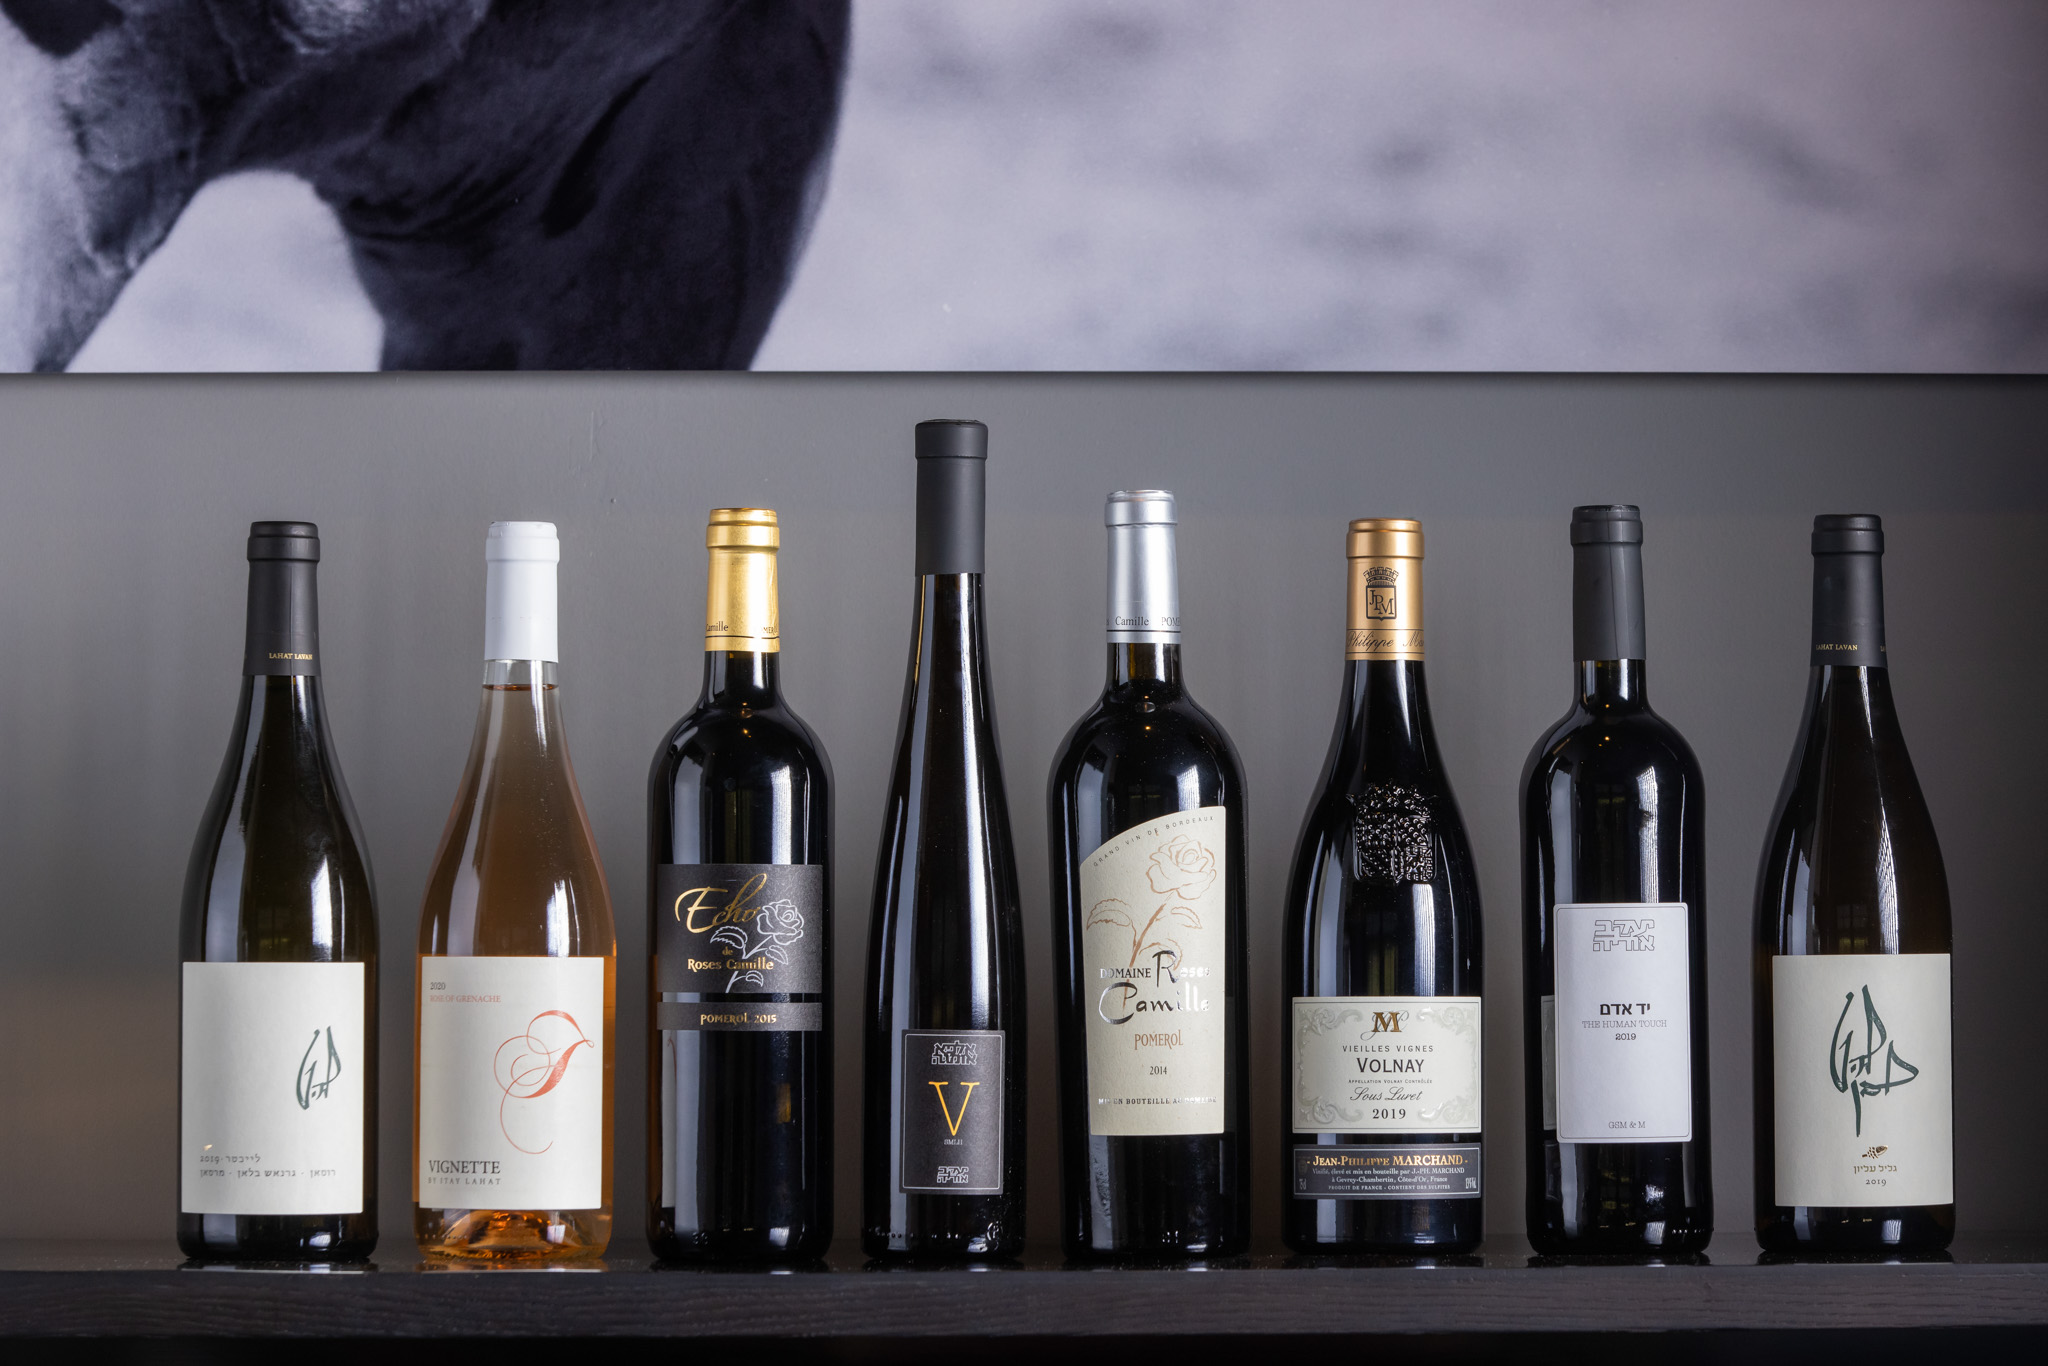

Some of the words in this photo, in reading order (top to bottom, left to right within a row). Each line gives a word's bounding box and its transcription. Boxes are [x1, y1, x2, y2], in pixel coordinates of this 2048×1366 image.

[1369, 589, 1394, 615] JPM
[1115, 615, 1149, 627] Camille
[1835, 643, 1858, 651] LAVAN
[269, 652, 293, 660] LAHAT
[1093, 846, 1120, 867] GRAND
[1125, 834, 1141, 845] VIN
[1147, 828, 1159, 836] DE
[1165, 815, 1214, 830] BORDEAUX
[674, 873, 768, 934] Echo
[722, 946, 733, 956] de
[687, 958, 722, 973] Roses
[726, 957, 774, 970] Camille
[1100, 967, 1151, 979] DOMAINE
[429, 981, 446, 990] 2020
[455, 994, 501, 1003] GRENACHE
[1098, 981, 1210, 1025] Camille
[1600, 1003, 1633, 1016] אדם
[1636, 1003, 1651, 1015] יד
[700, 1013, 748, 1025] POMEROL
[754, 1014, 777, 1024] 2015
[1582, 1021, 1601, 1029] THE
[1602, 1020, 1637, 1028] HUMAN
[1639, 1020, 1667, 1028] TOUCH
[1134, 1029, 1184, 1050] POMEROL
[1615, 1032, 1637, 1041] 2019
[1342, 1045, 1390, 1053] VIEILLES
[1396, 1045, 1434, 1053] VIGNES
[1149, 1066, 1168, 1075] 2014
[1356, 1057, 1425, 1073] VOLNAY
[1349, 1086, 1383, 1101] Sous
[1384, 1086, 1424, 1101] Luret
[928, 1081, 980, 1136] V
[1372, 1108, 1406, 1120] 2019
[1608, 1121, 1628, 1129] GSM
[1638, 1121, 1646, 1129] M
[1393, 1154, 1463, 1166] MARCHAND
[428, 1160, 501, 1174] VIGNETTE
[1866, 1179, 1887, 1187] 2019
